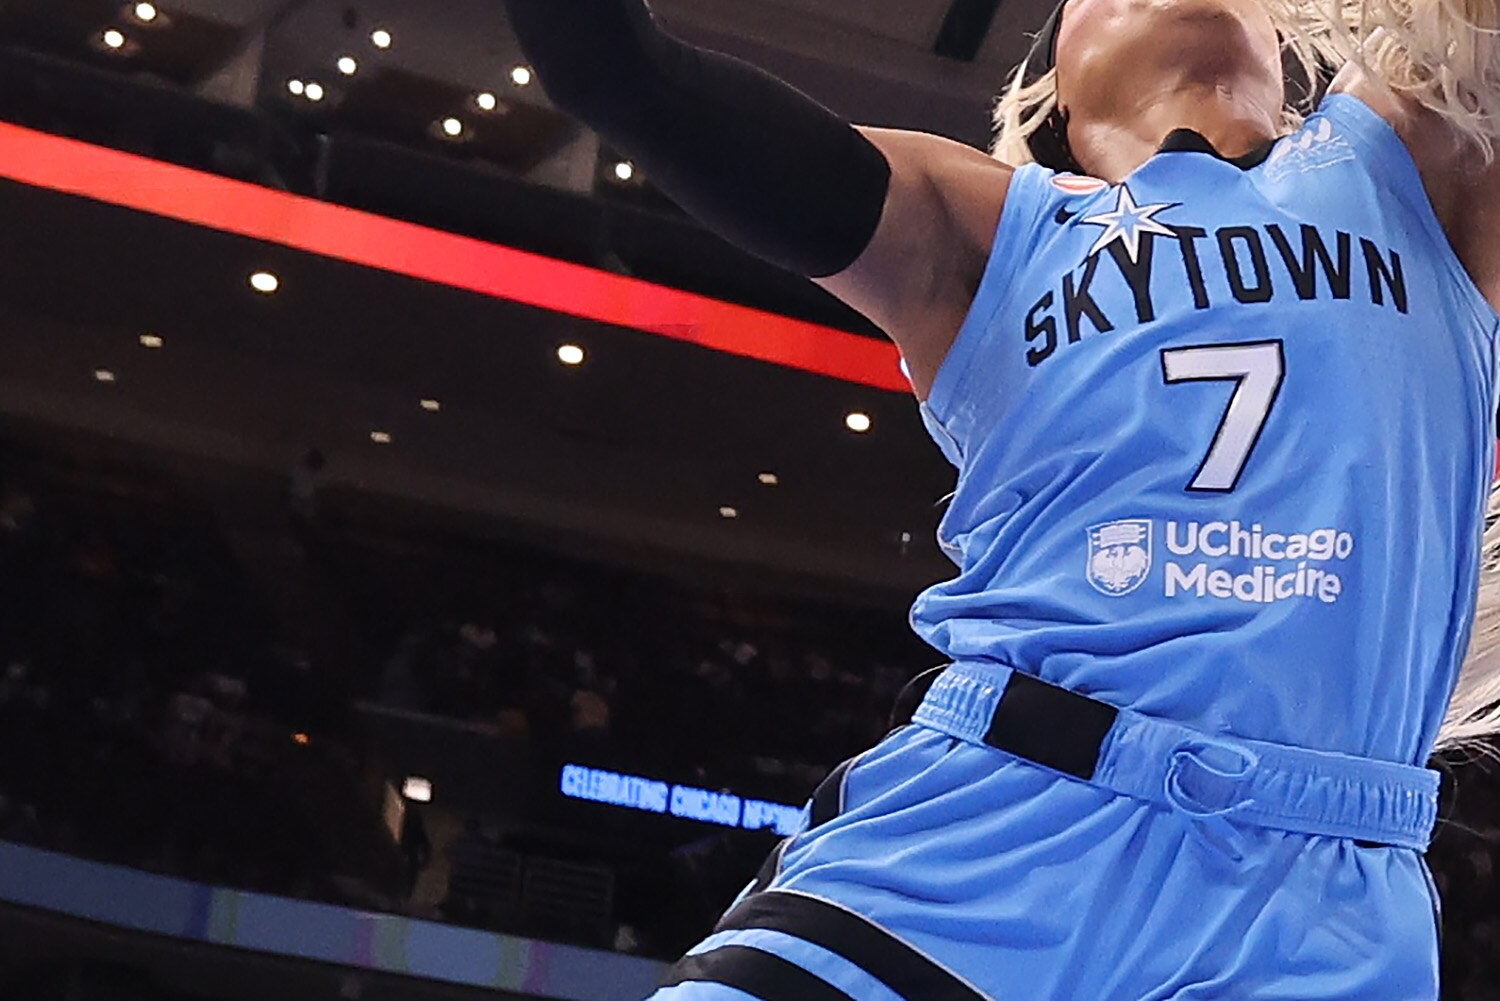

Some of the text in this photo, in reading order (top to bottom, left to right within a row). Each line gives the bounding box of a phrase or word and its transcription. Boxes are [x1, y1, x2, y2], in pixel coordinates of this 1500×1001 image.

[1025, 223, 1409, 367] SKYTOWN
[1160, 338, 1285, 494] 7
[1166, 520, 1353, 560] UChicago
